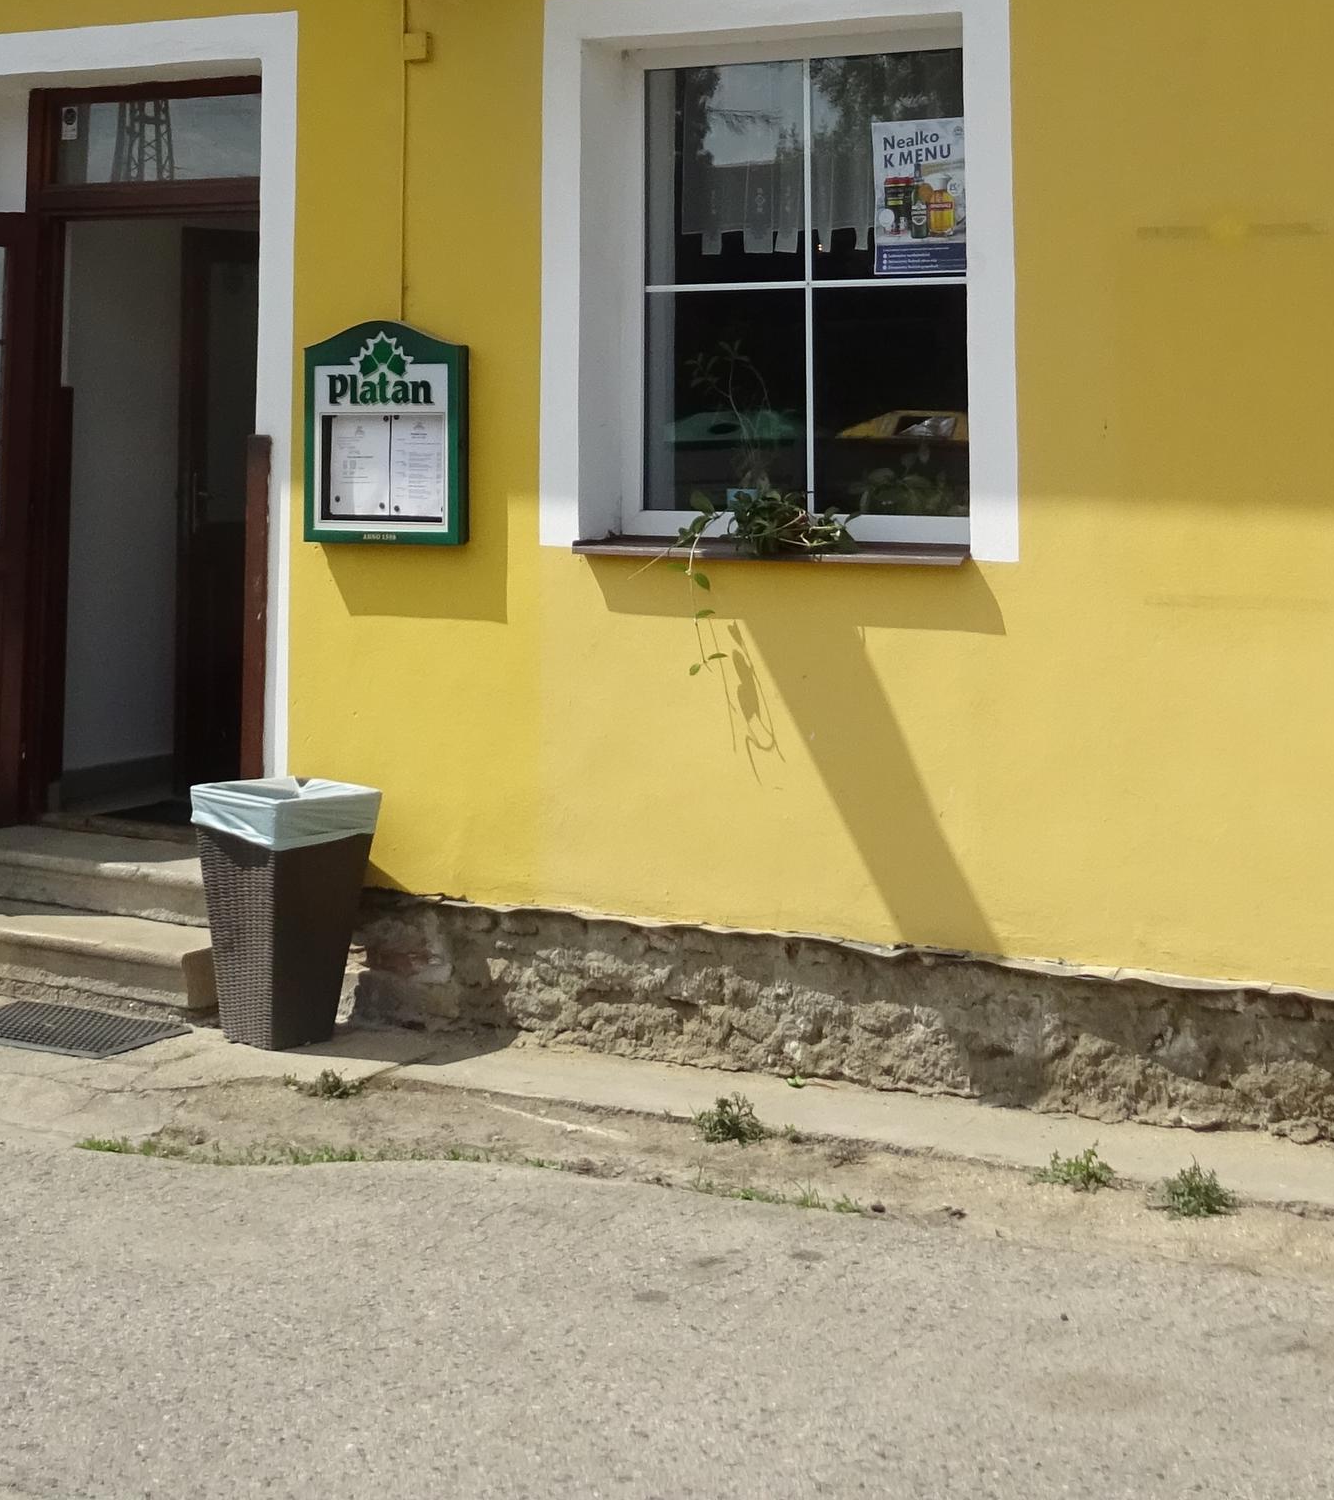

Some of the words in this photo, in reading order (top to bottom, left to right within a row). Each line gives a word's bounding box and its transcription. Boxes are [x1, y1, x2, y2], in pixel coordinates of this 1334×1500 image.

[883, 131, 939, 151] Nealko
[884, 153, 895, 169] K
[898, 143, 952, 167] MENU
[327, 371, 435, 405] Platan
